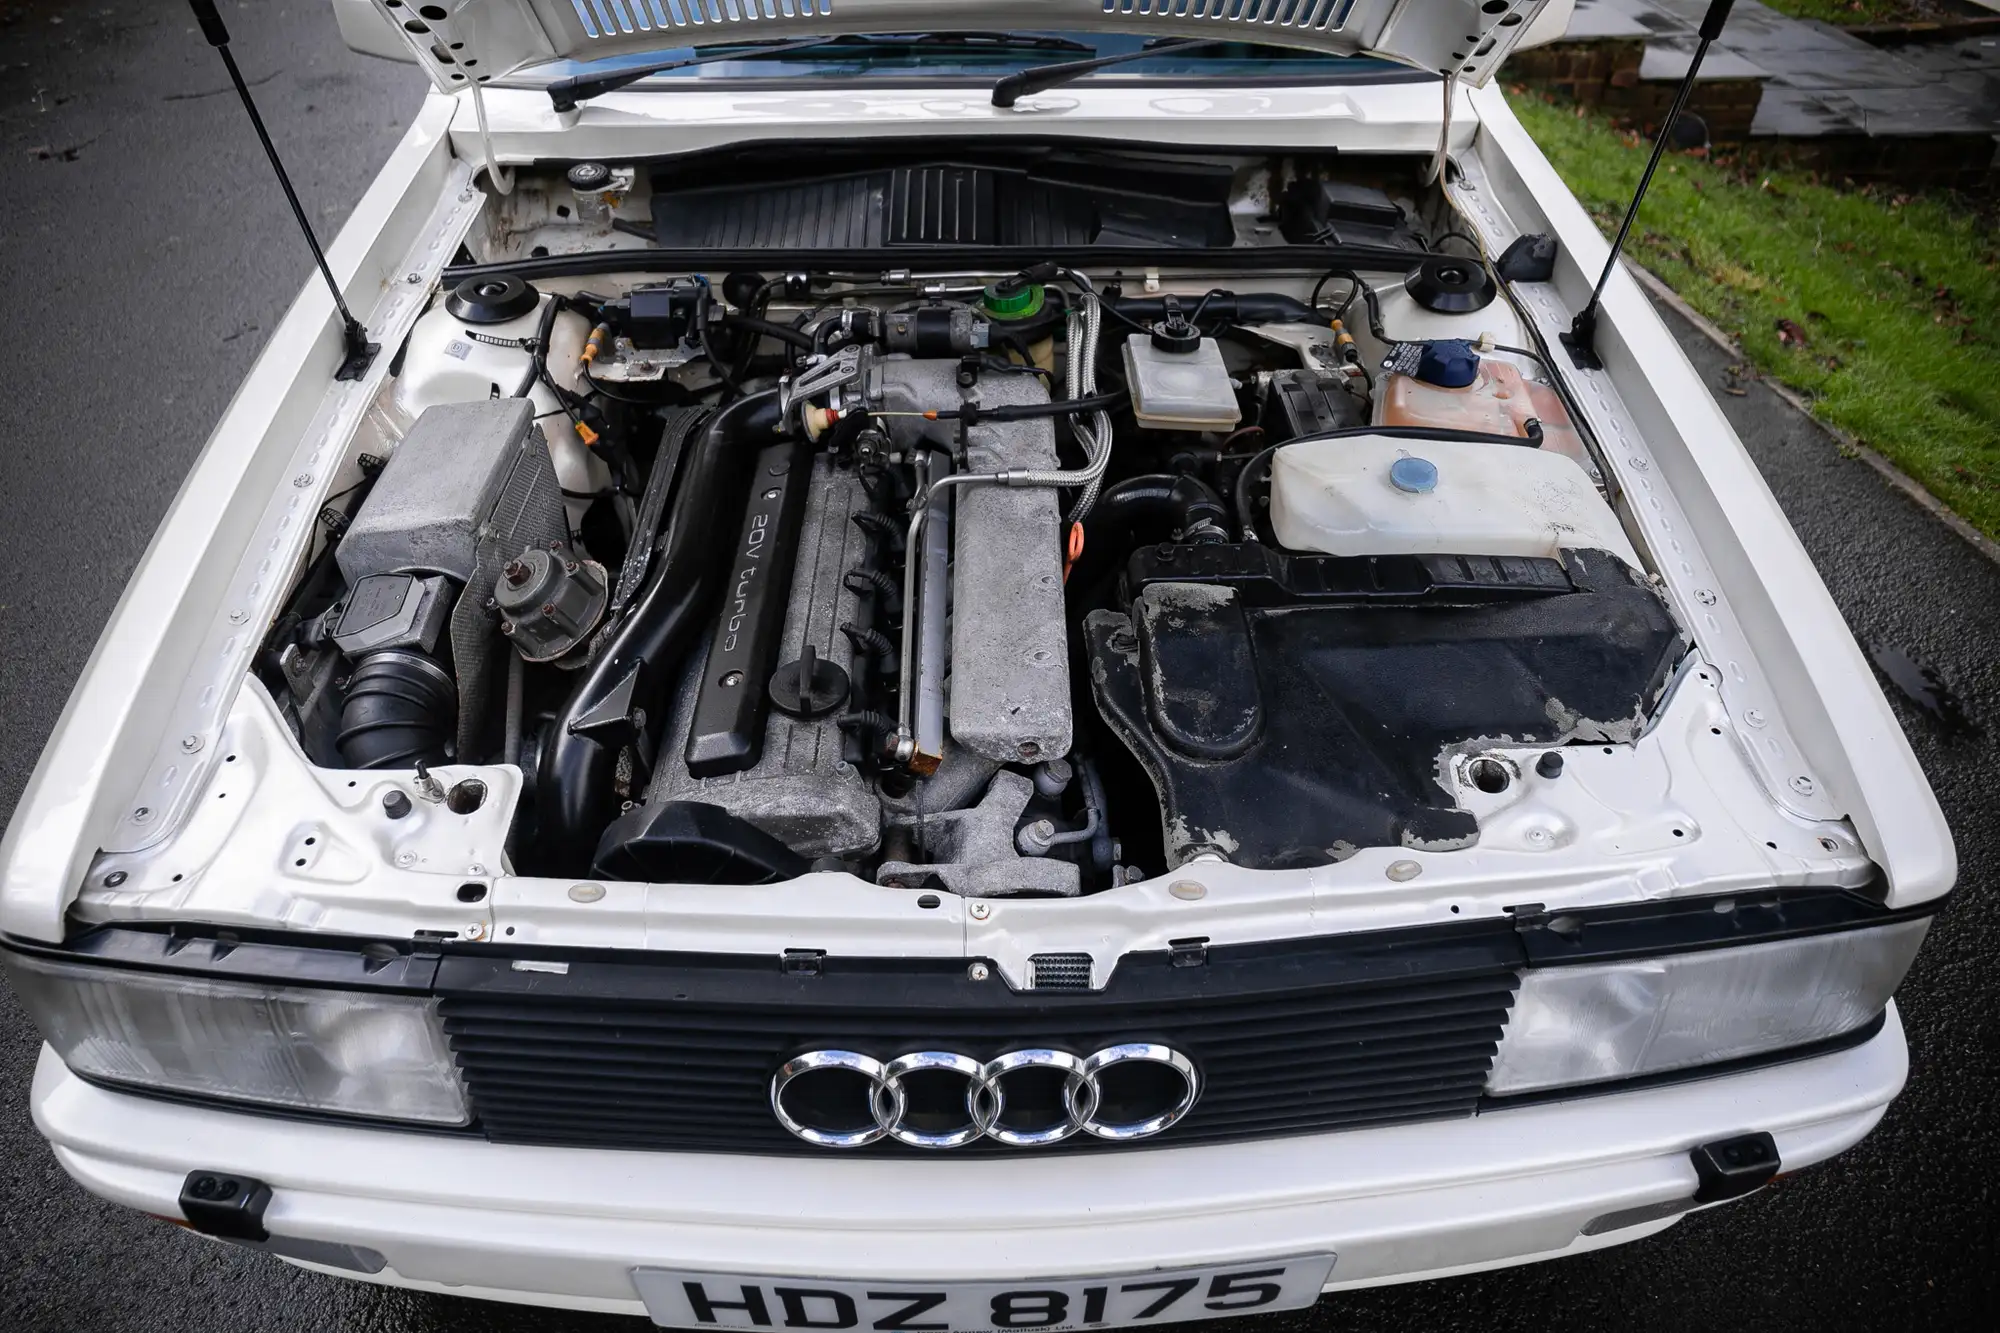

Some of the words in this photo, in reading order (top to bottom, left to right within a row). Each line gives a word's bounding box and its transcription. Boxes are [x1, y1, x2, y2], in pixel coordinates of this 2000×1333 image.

[745, 514, 768, 559] 20V
[724, 567, 757, 651] turbo
[682, 1281, 949, 1330] HDZ
[990, 1267, 1287, 1327] 8175
